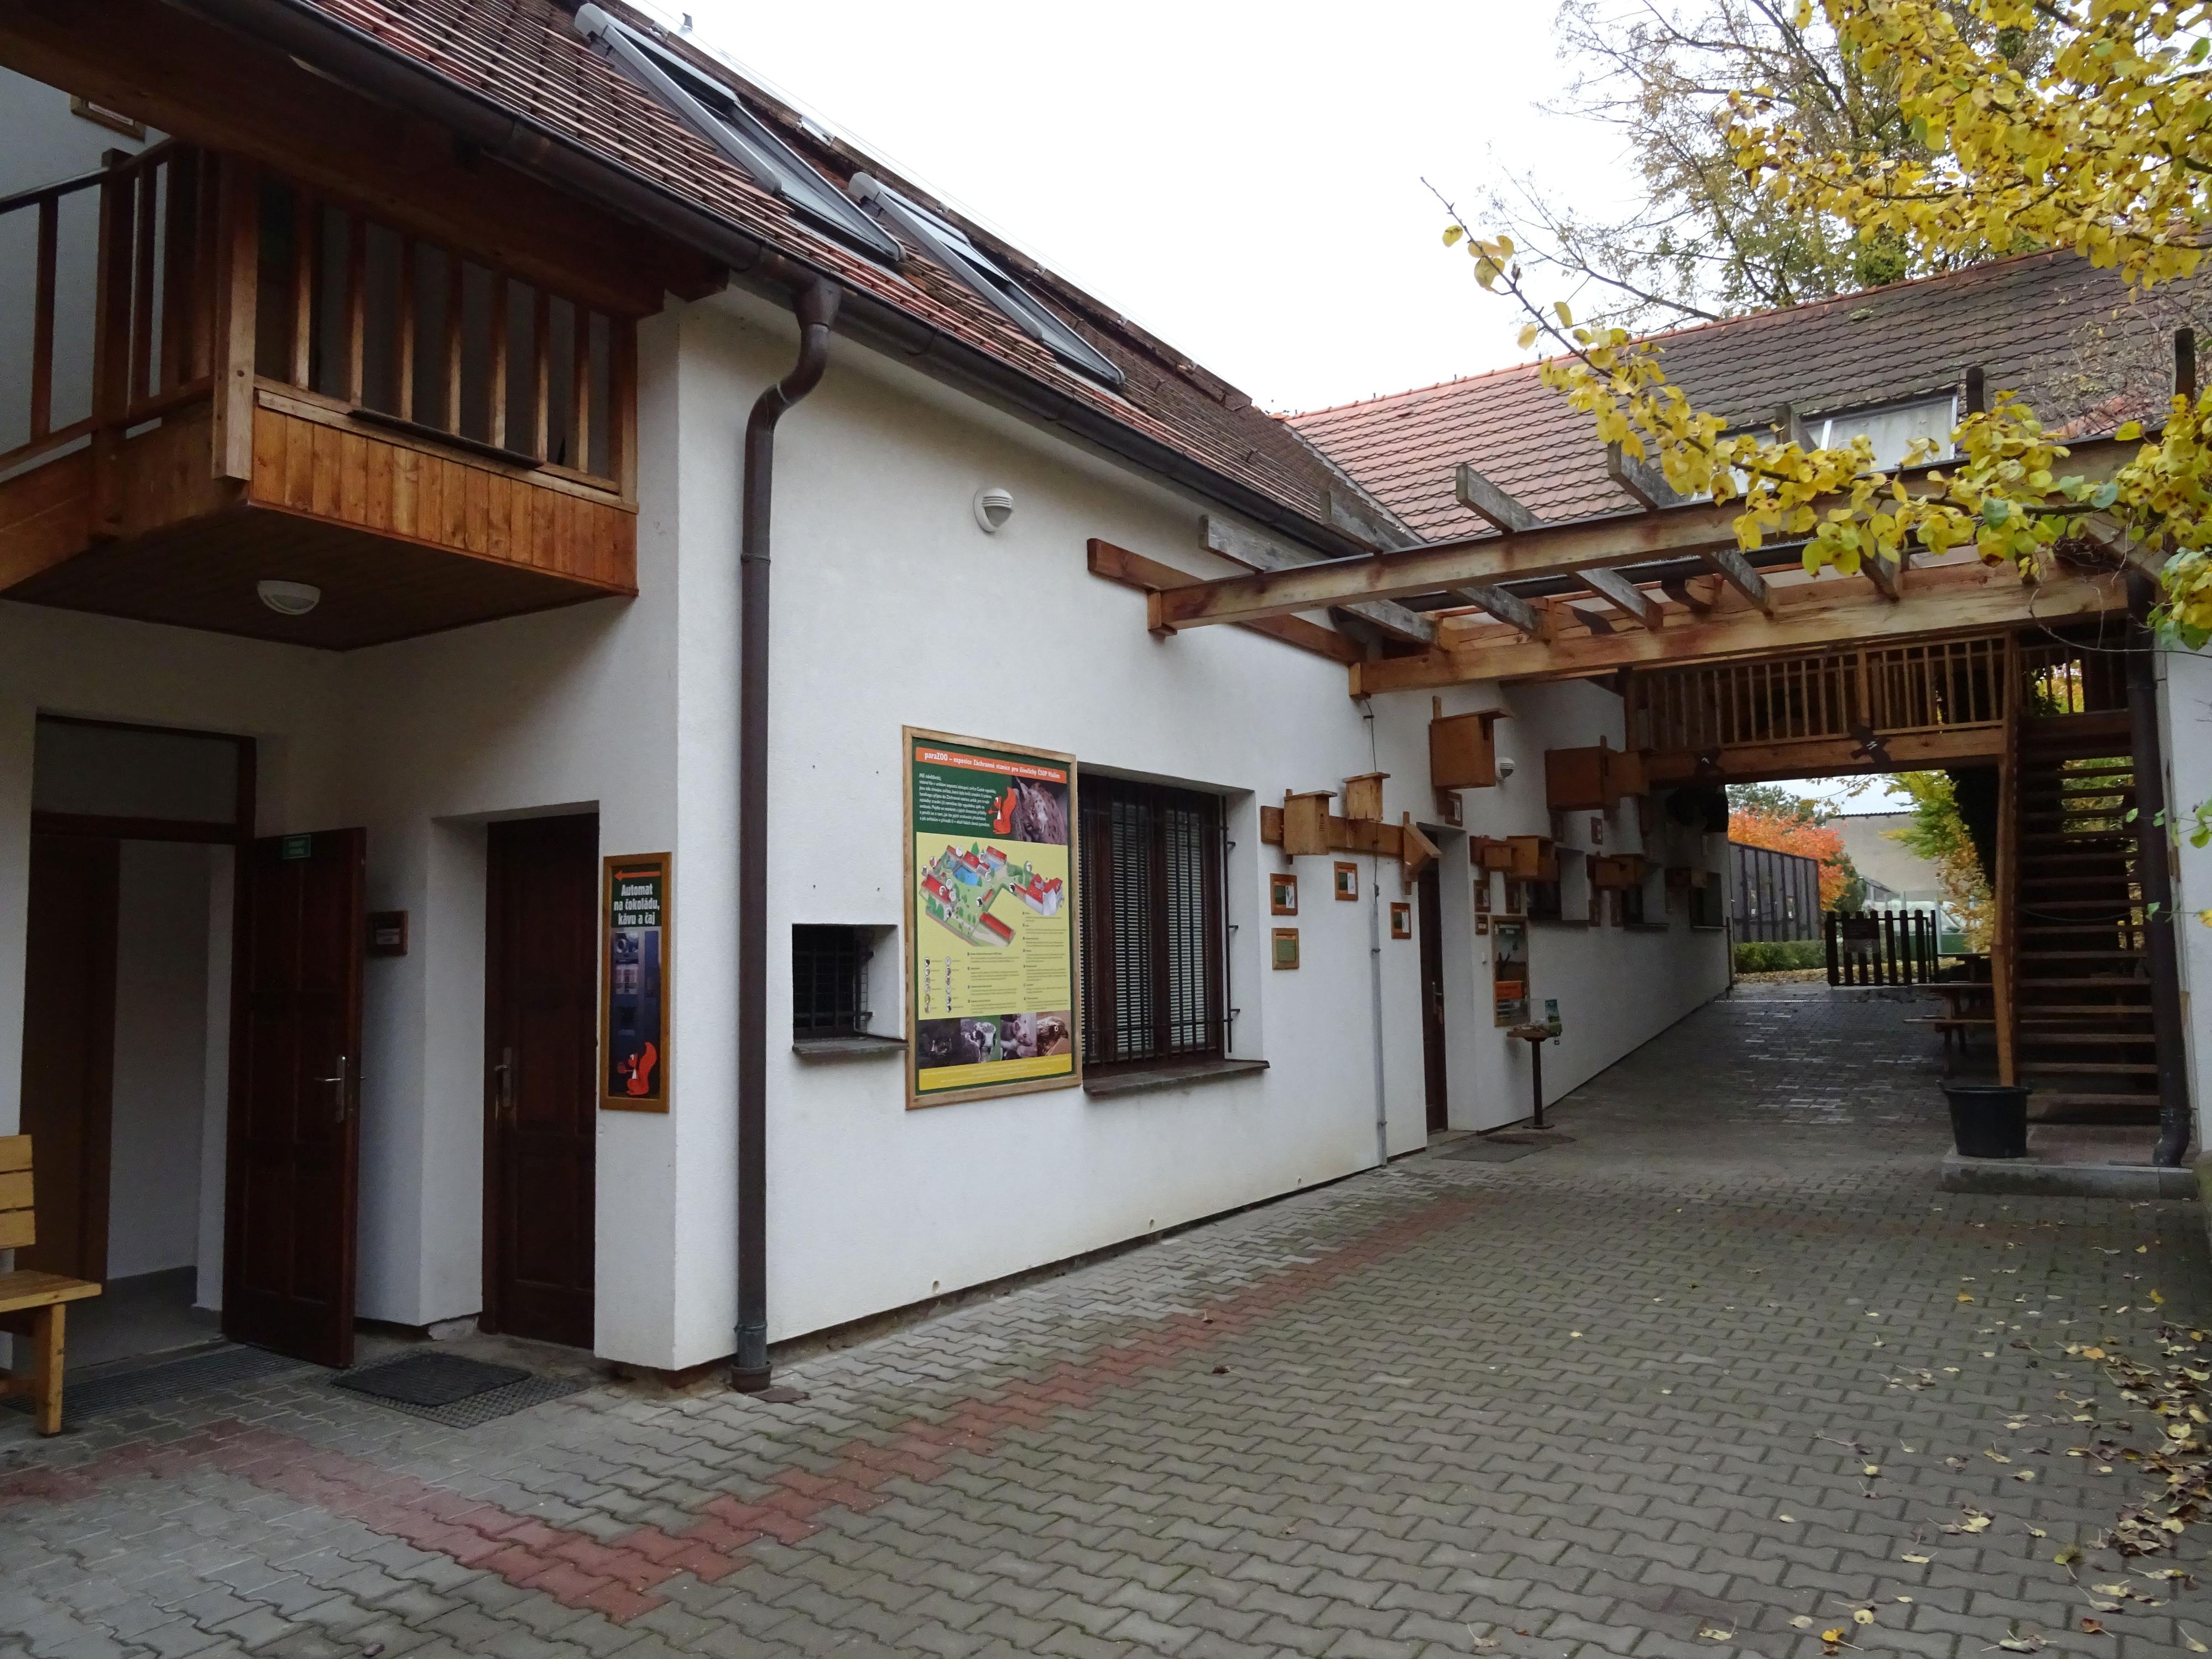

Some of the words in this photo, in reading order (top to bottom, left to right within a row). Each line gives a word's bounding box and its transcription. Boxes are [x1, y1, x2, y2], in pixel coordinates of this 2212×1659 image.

[925, 752, 948, 761] paraZOO
[621, 883, 653, 896] Automat
[614, 901, 623, 911] na
[625, 898, 660, 911] čokoládu,
[618, 912, 636, 925] kávu
[638, 914, 643, 925] a
[645, 912, 655, 925] čaj
